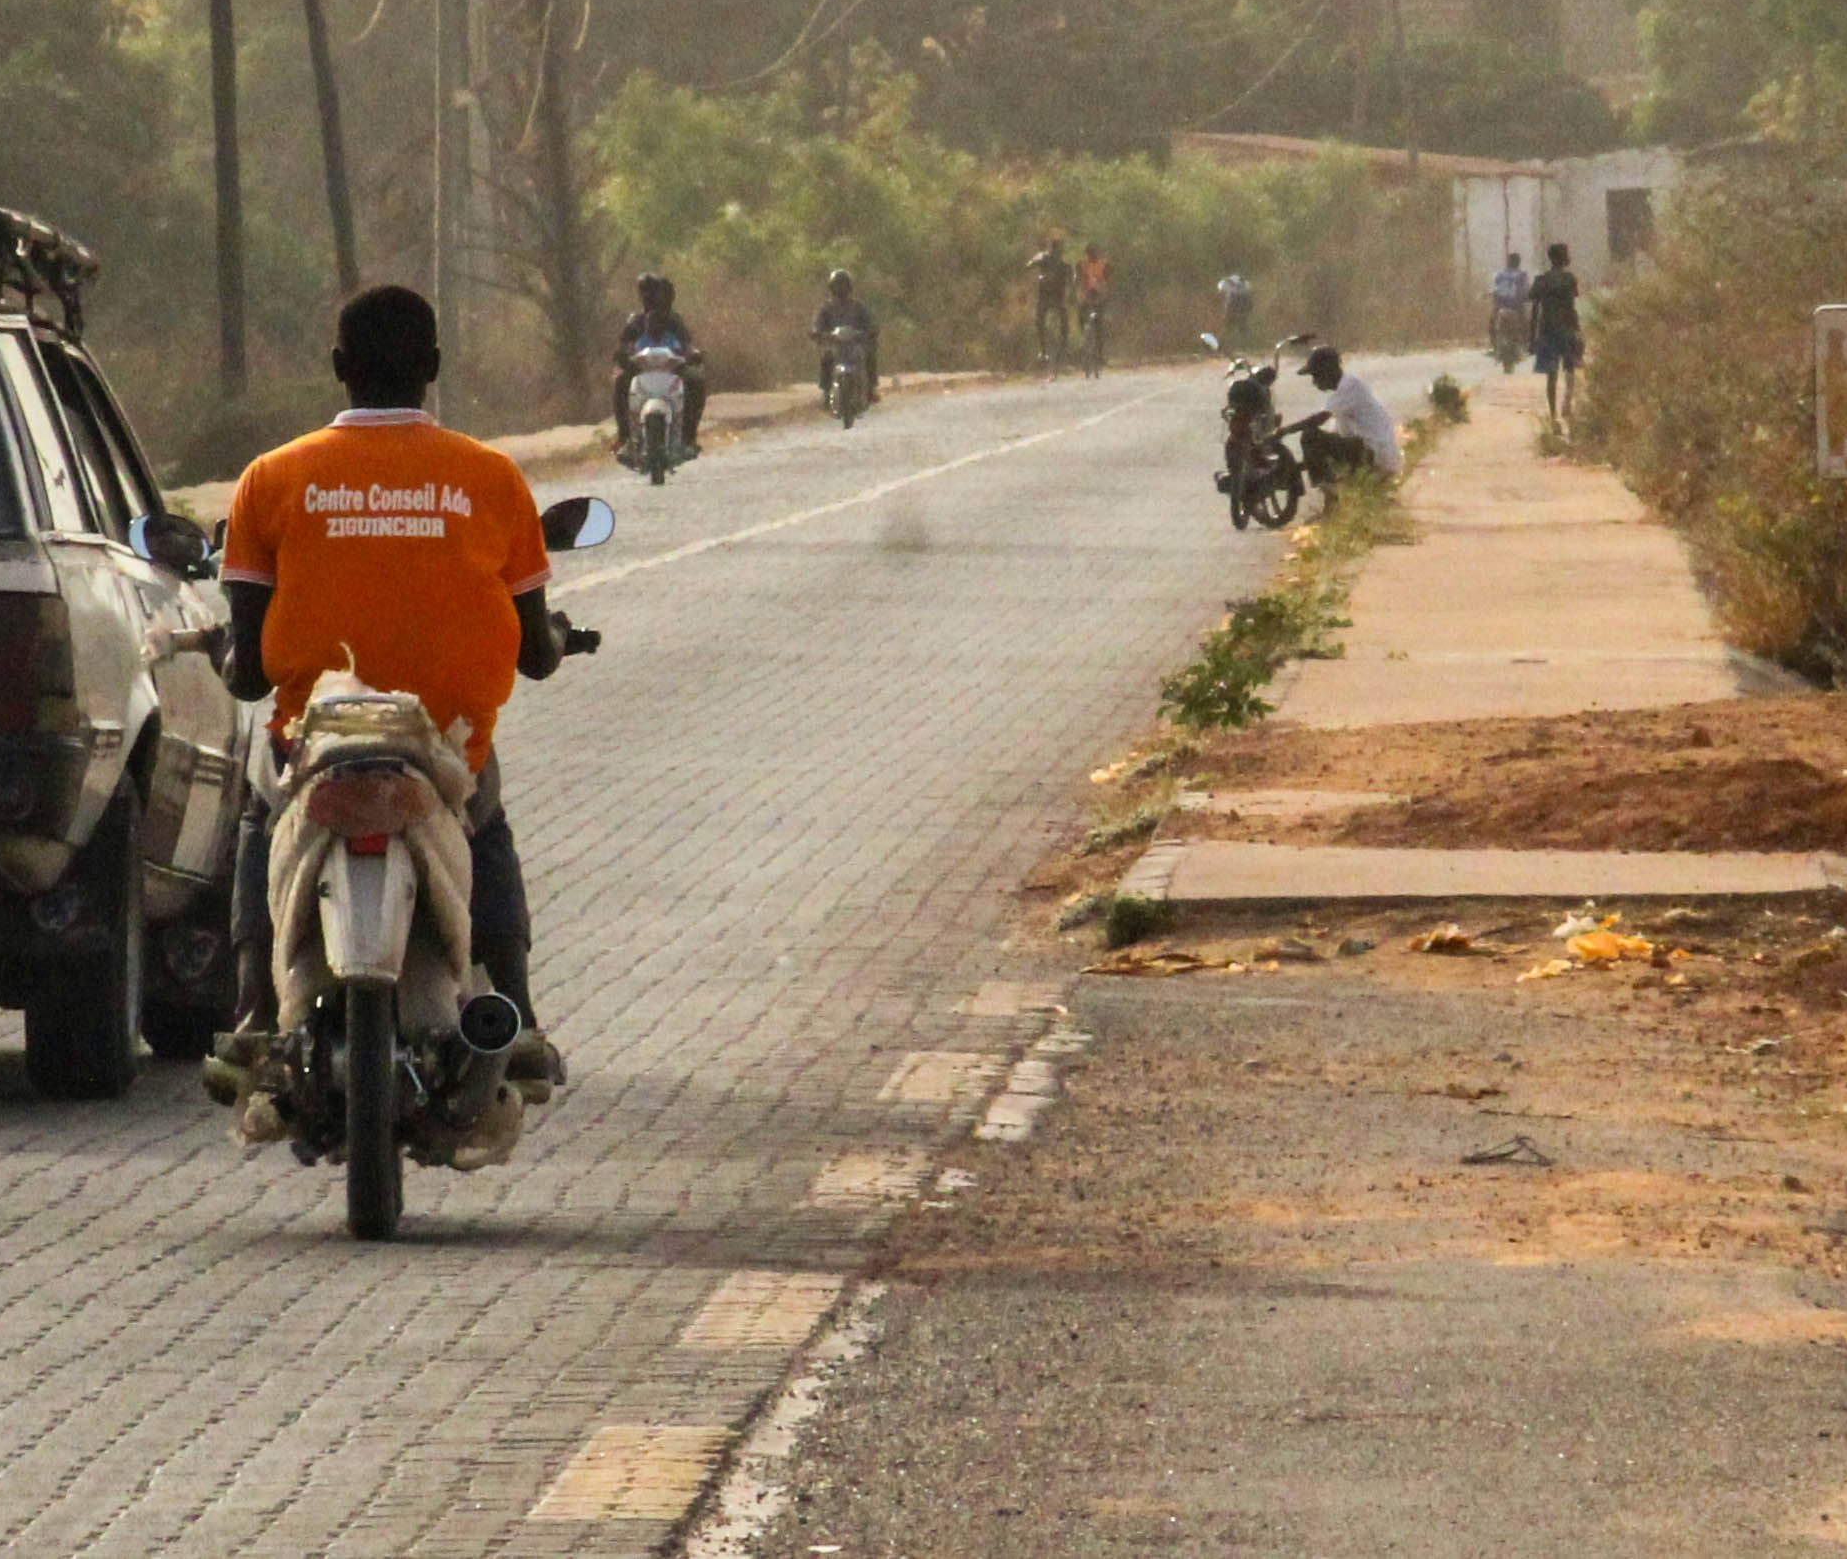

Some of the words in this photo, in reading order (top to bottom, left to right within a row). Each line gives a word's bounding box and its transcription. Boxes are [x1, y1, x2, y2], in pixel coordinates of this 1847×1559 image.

[305, 483, 365, 513] Centre
[368, 483, 436, 512] Conseil
[327, 516, 445, 538] ZIGUINCHOR
